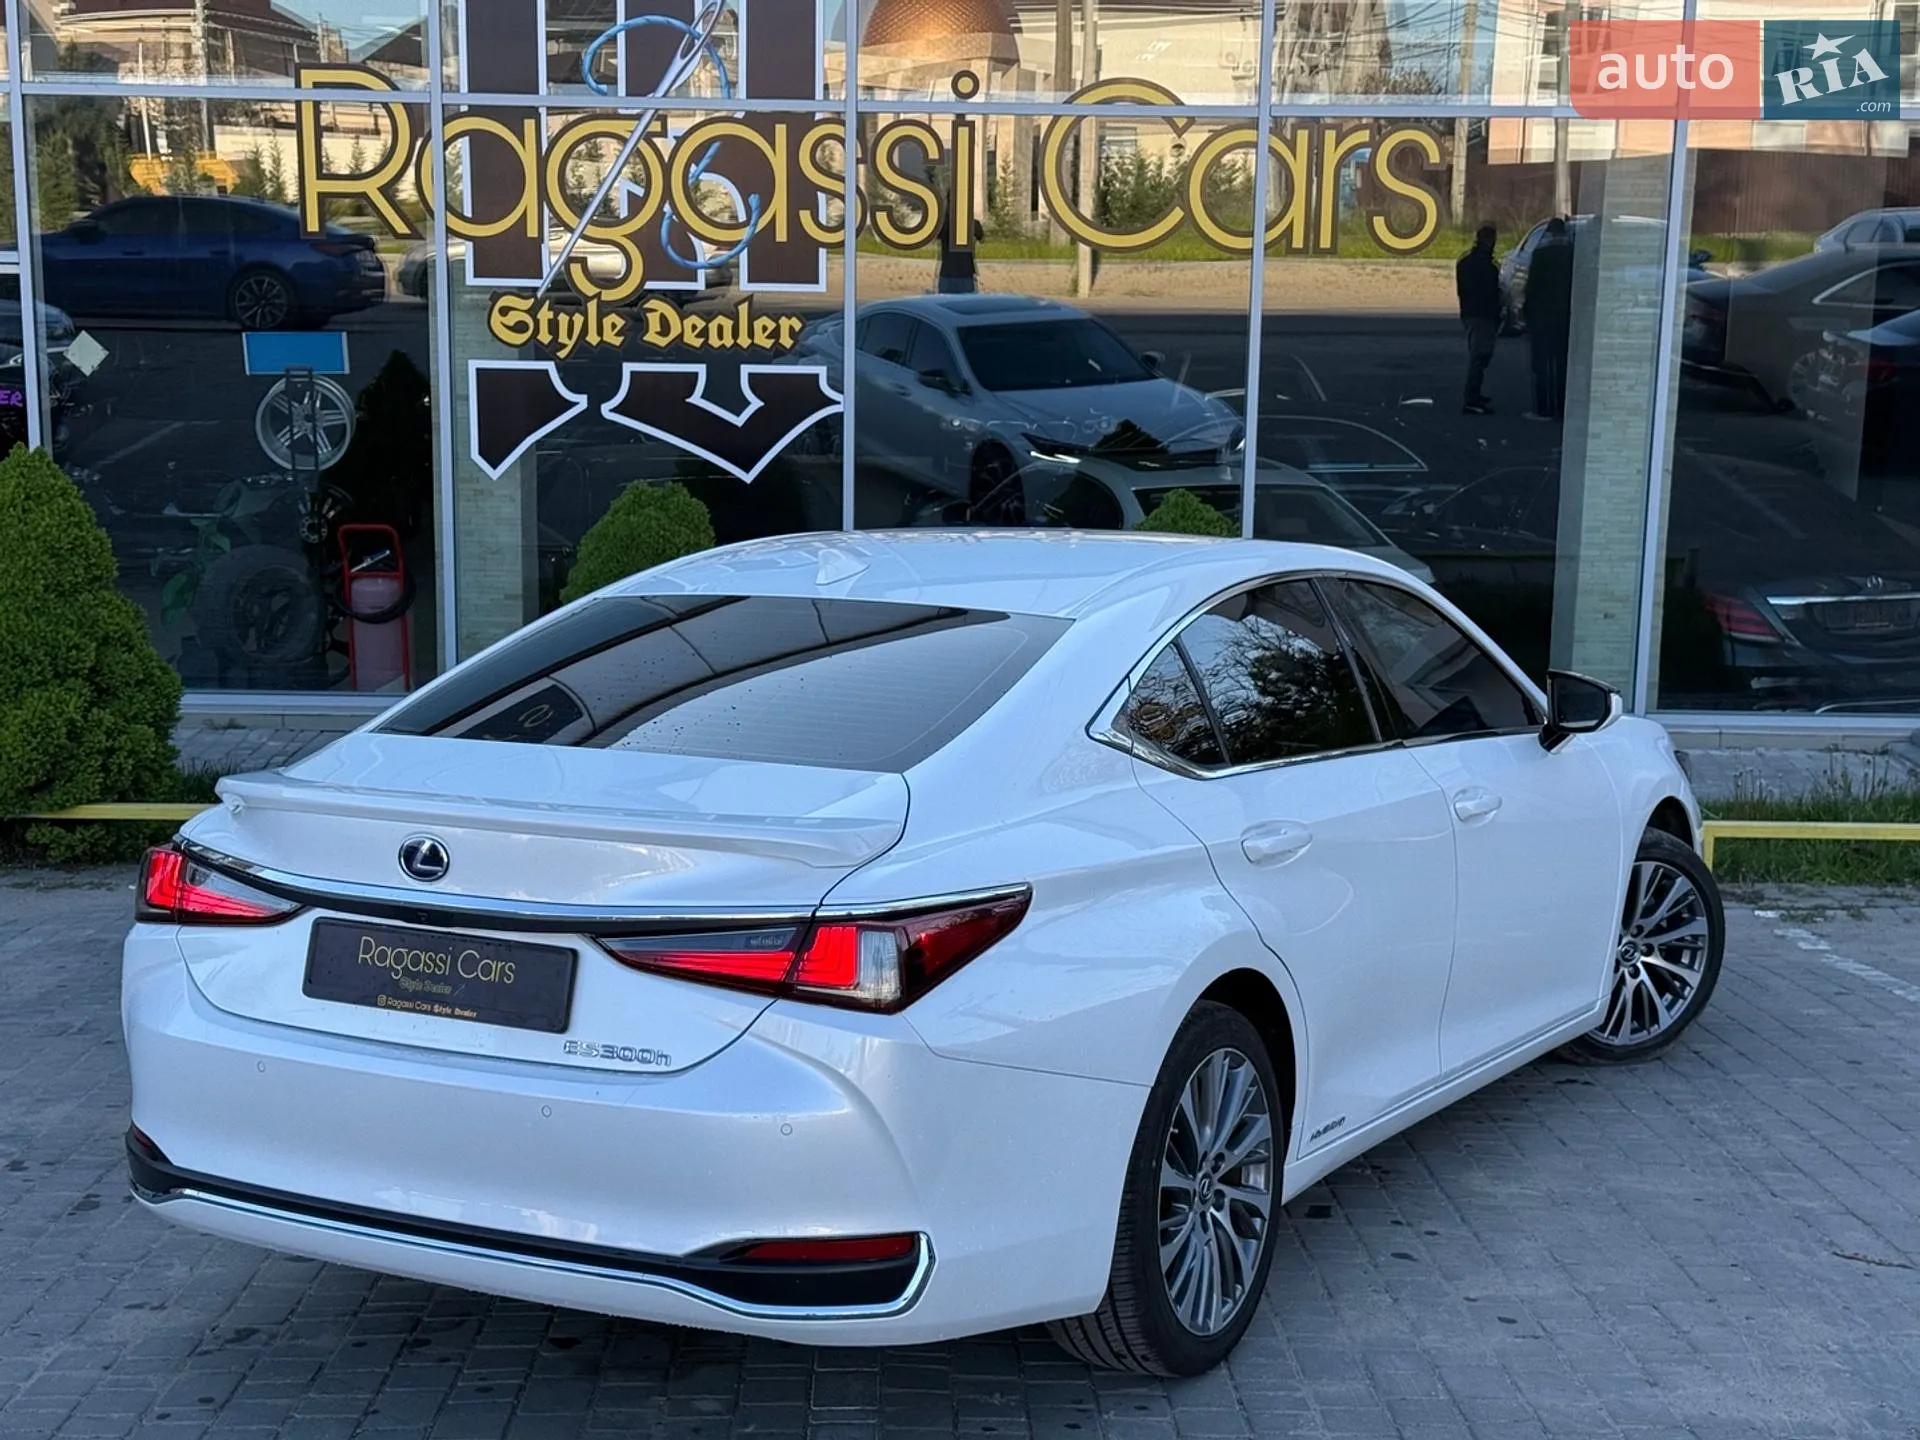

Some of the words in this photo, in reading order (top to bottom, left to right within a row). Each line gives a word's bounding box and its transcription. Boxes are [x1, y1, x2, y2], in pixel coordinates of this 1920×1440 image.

[296, 62, 980, 302] Ragassi
[1040, 77, 1446, 256] Cars
[489, 293, 627, 360] Style
[640, 297, 804, 350] Dealer
[358, 935, 453, 980] Ragassi
[457, 949, 516, 984] Cars
[563, 1039, 672, 1068] ES300h
